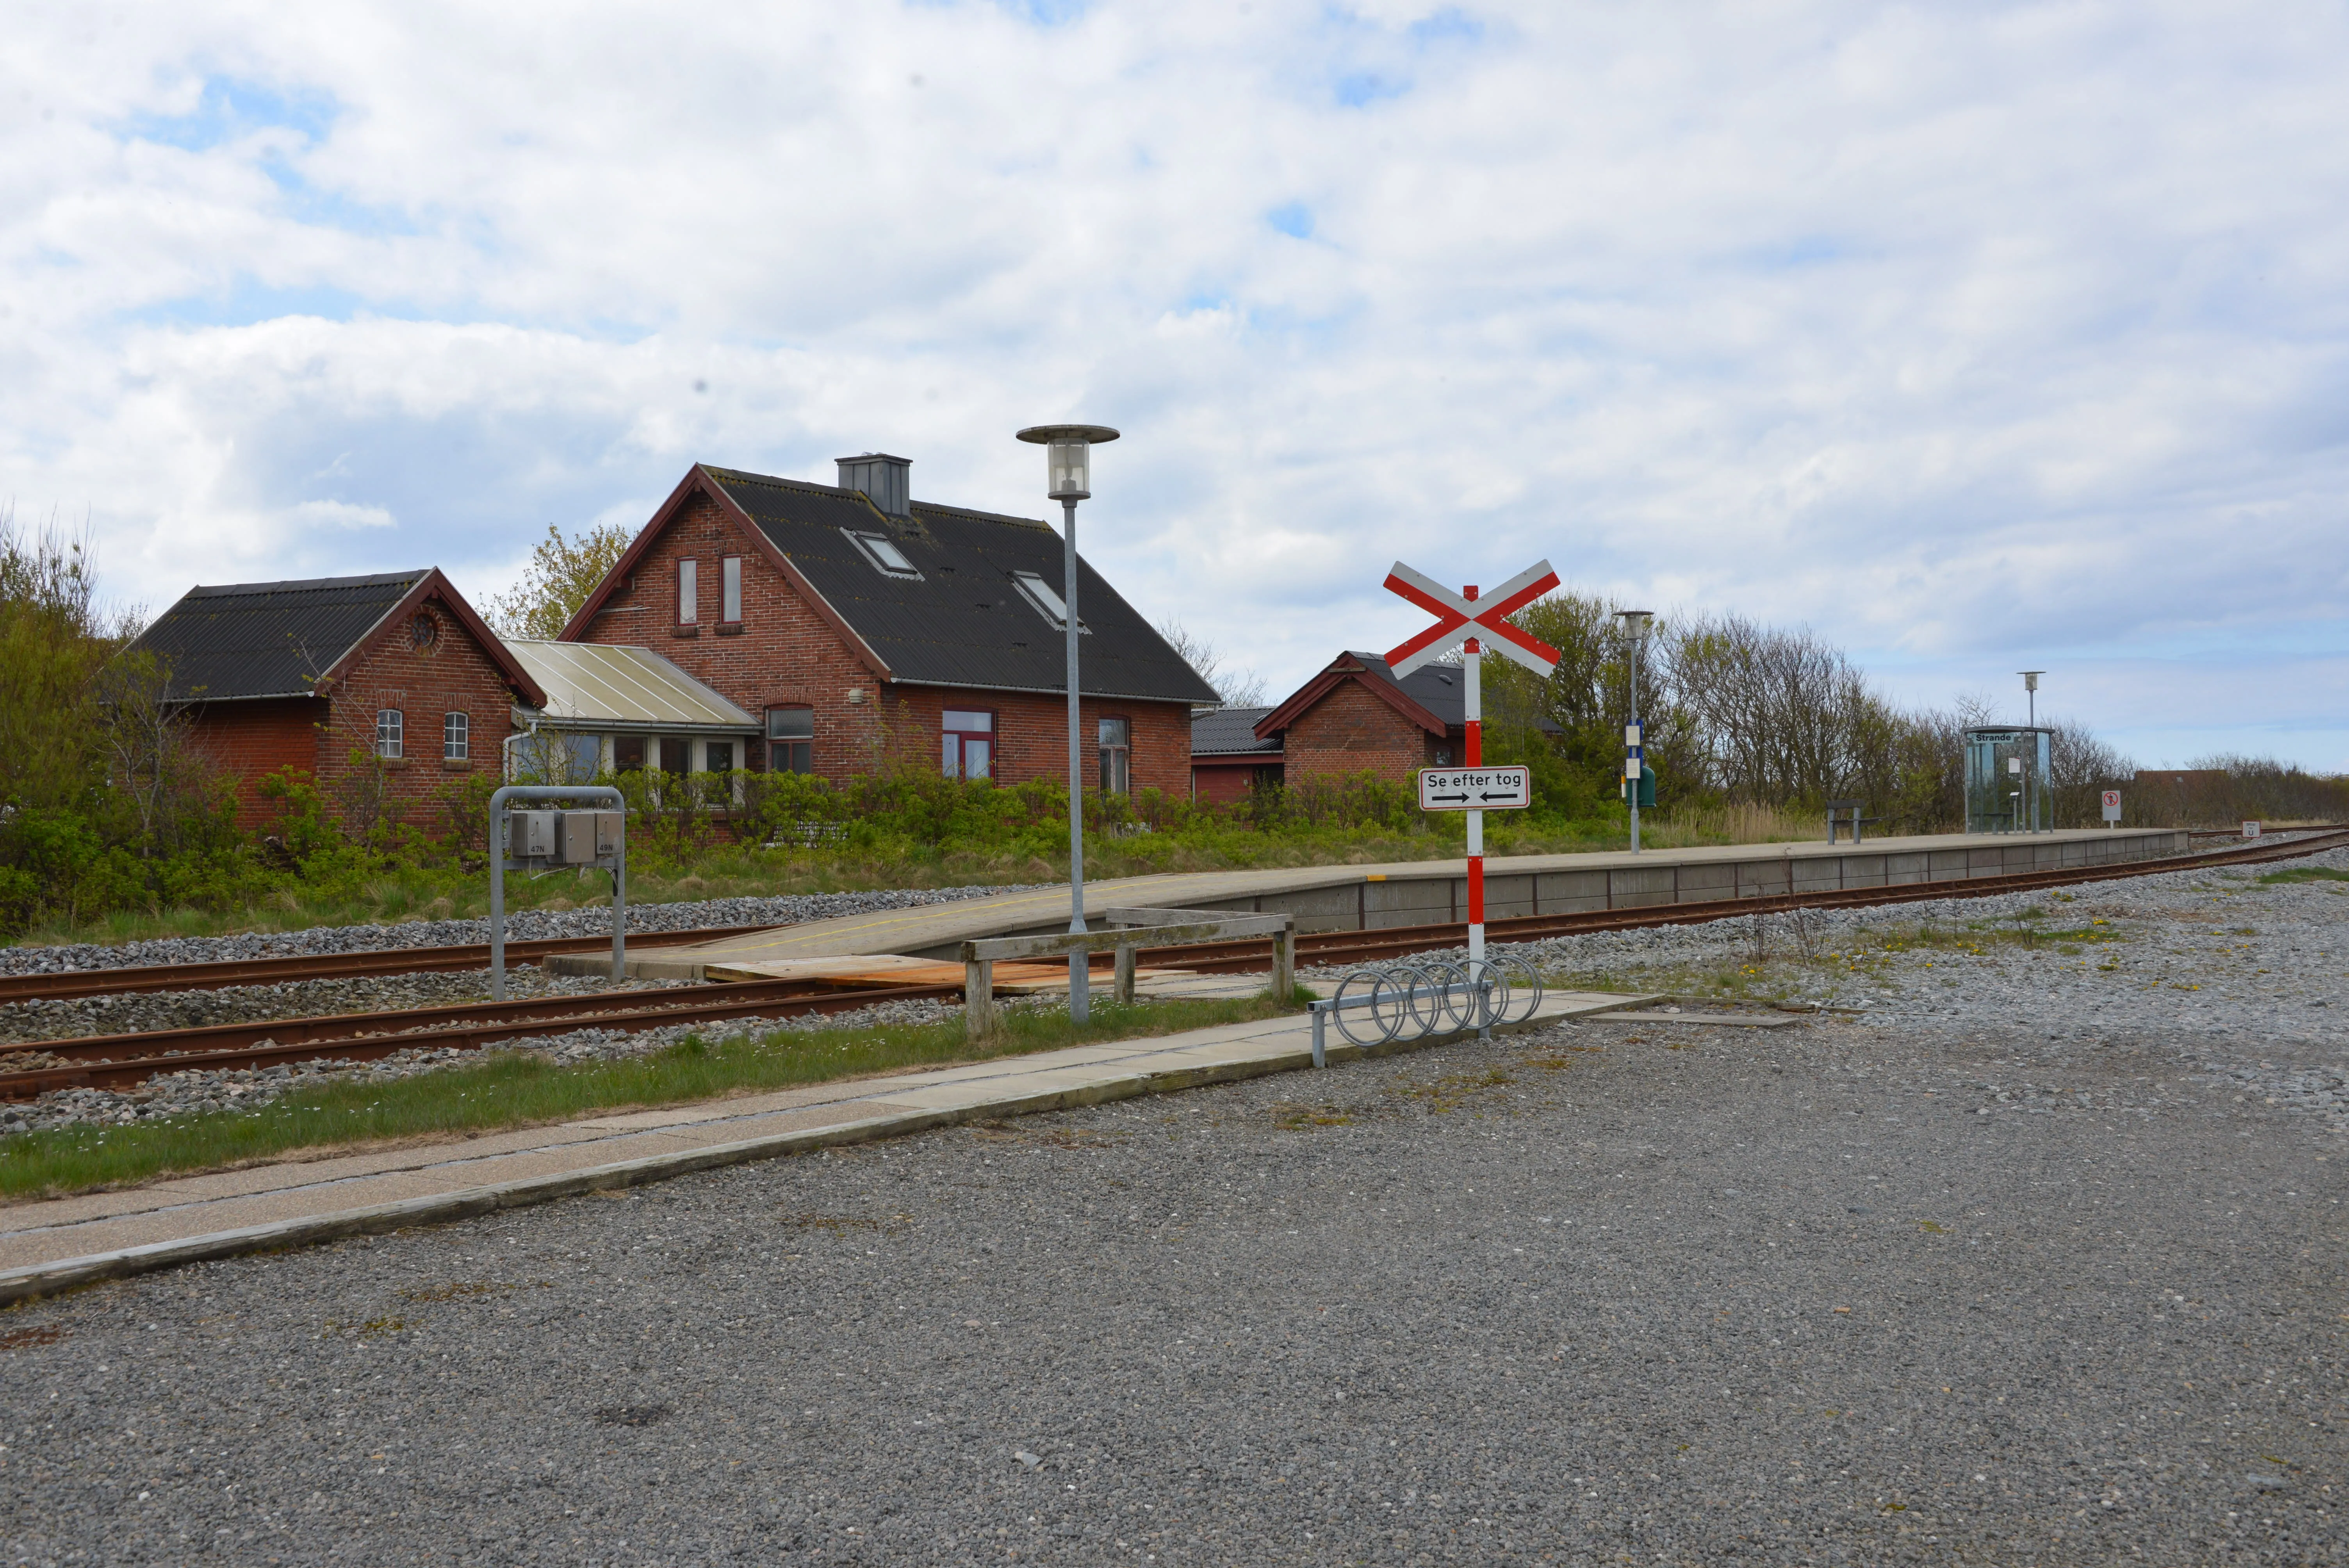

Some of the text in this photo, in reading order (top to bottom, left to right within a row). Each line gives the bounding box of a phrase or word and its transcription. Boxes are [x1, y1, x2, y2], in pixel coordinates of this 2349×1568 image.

[1428, 773, 1521, 787] Se efter tog
